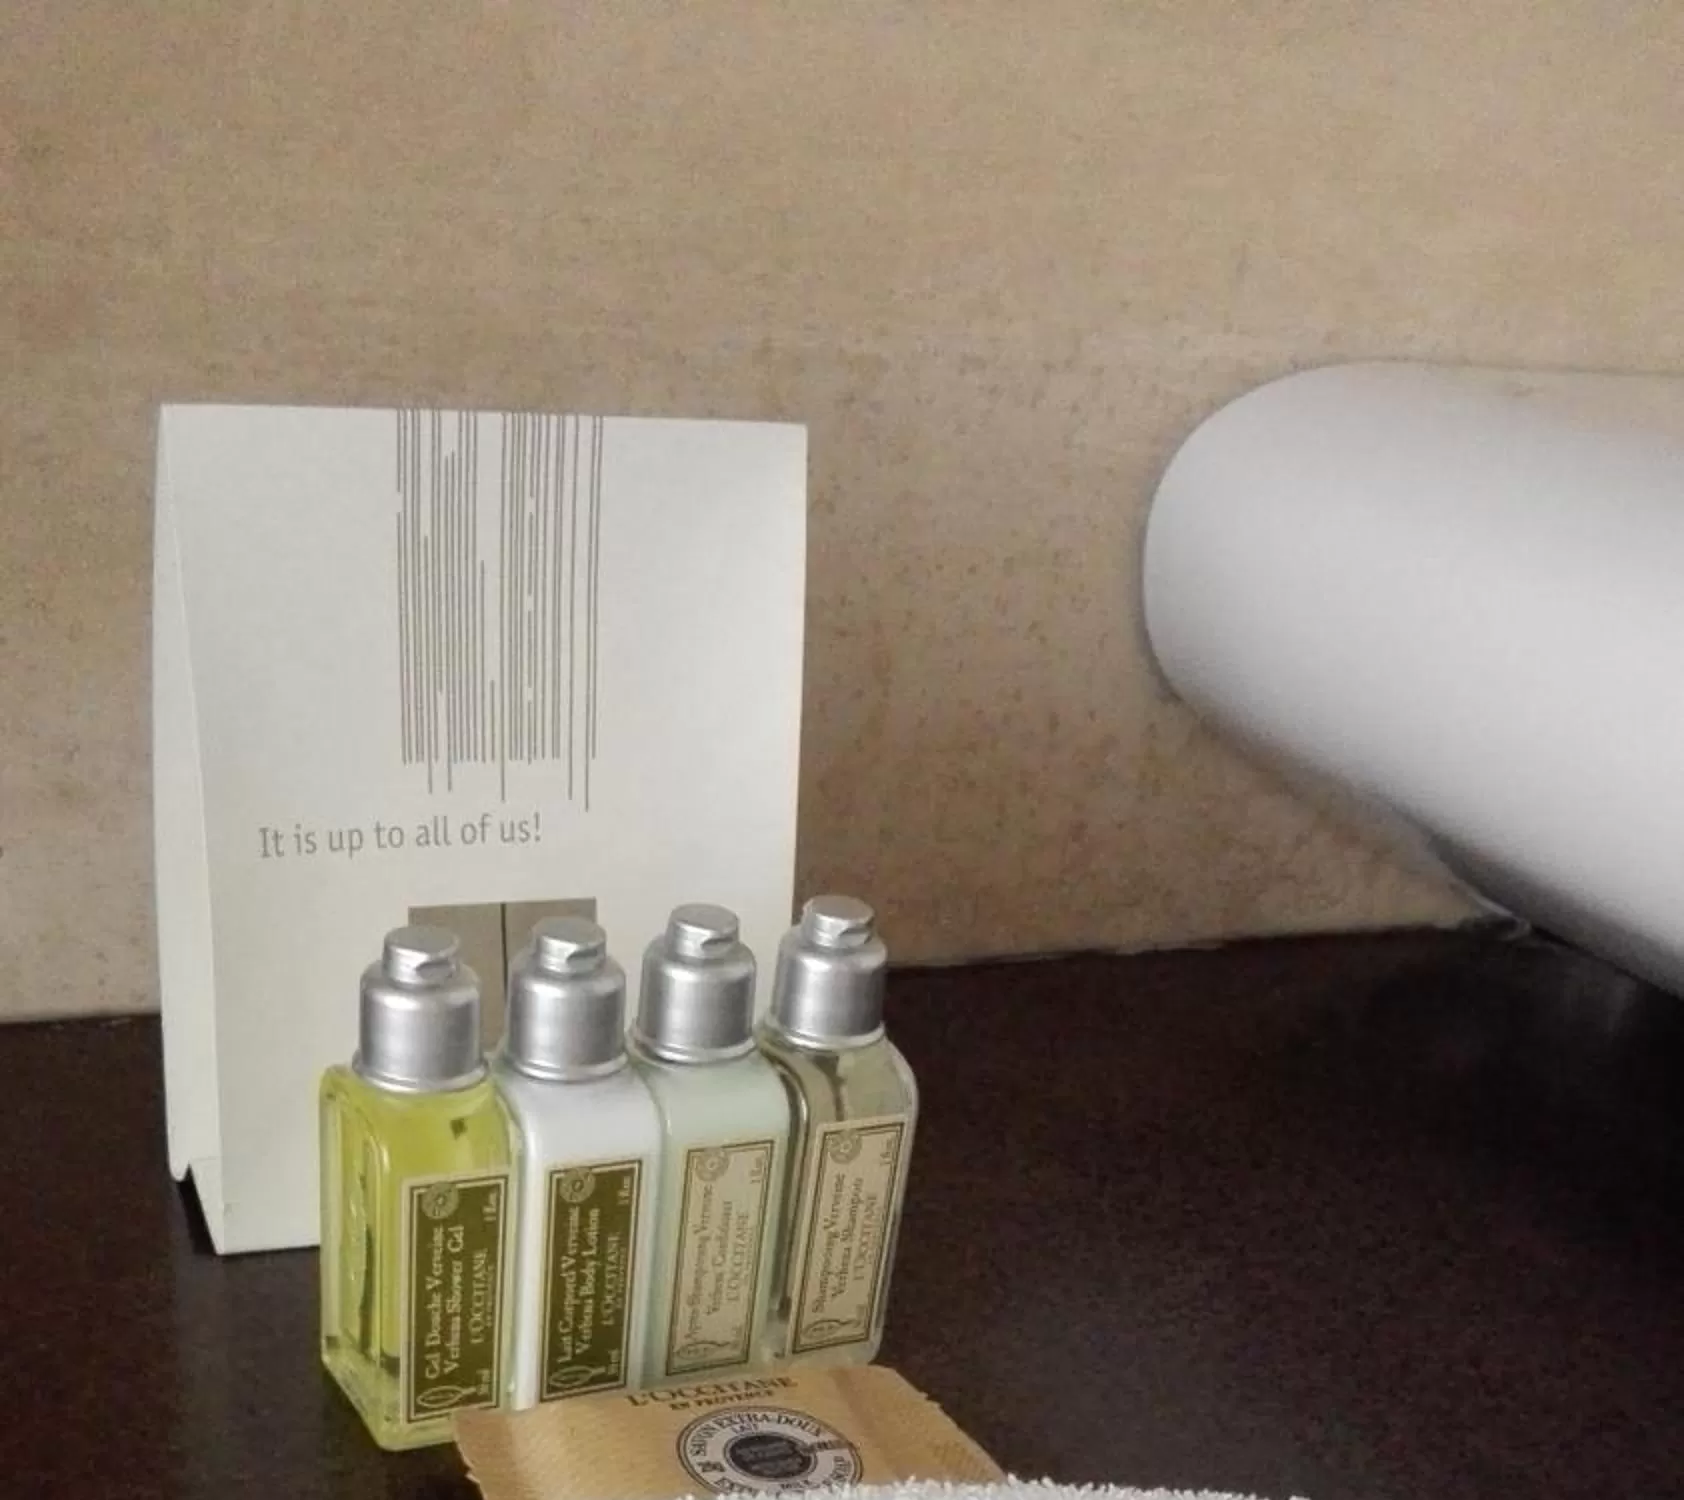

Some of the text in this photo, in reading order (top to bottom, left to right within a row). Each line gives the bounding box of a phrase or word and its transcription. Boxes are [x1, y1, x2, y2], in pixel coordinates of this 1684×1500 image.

[258, 811, 542, 859] It is up to all of us!
[580, 1207, 601, 1257] Lotion
[445, 1260, 464, 1314] Shower
[579, 1259, 602, 1297] Body
[627, 1377, 798, 1407] L'OCCITANE
